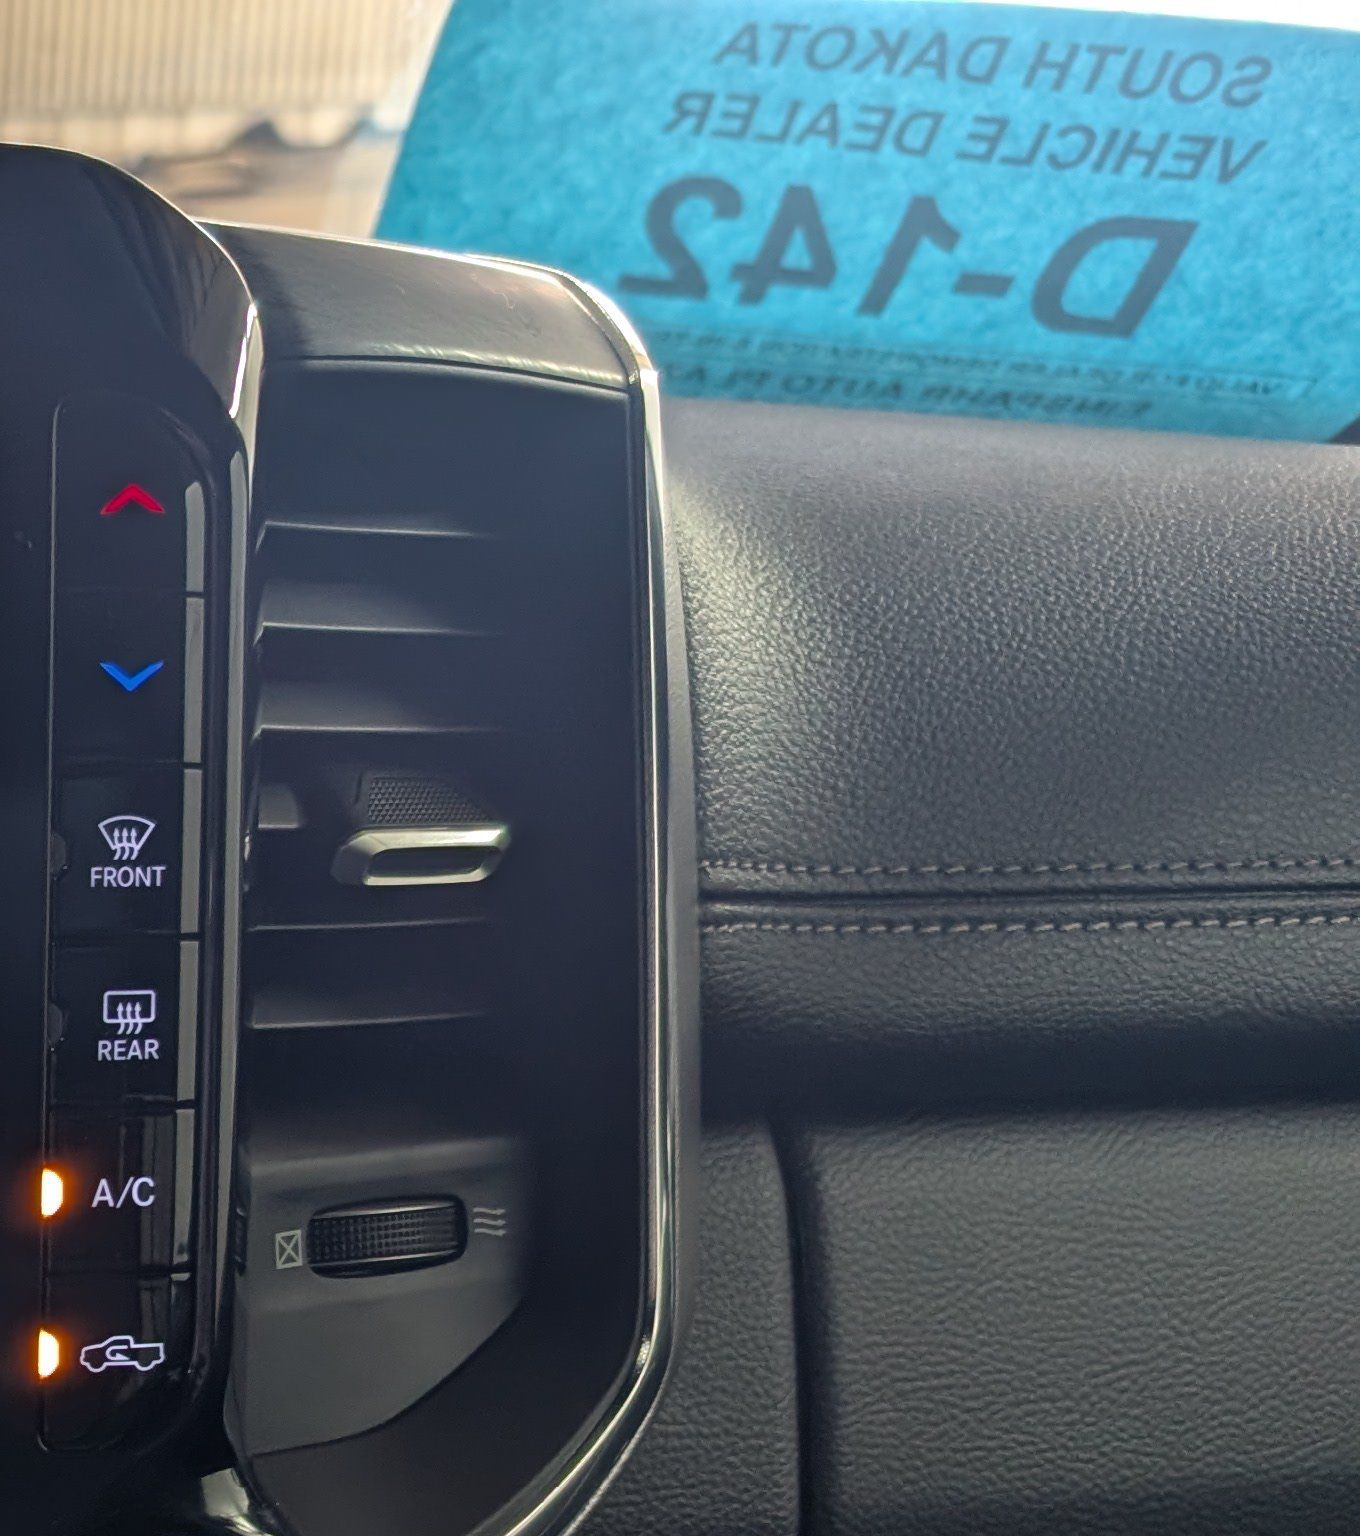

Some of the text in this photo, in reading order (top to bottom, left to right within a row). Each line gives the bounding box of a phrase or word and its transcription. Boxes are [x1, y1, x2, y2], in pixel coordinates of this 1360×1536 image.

[90, 866, 166, 888] FRONT
[97, 1038, 159, 1061] REAR
[91, 1176, 155, 1208] A/C
